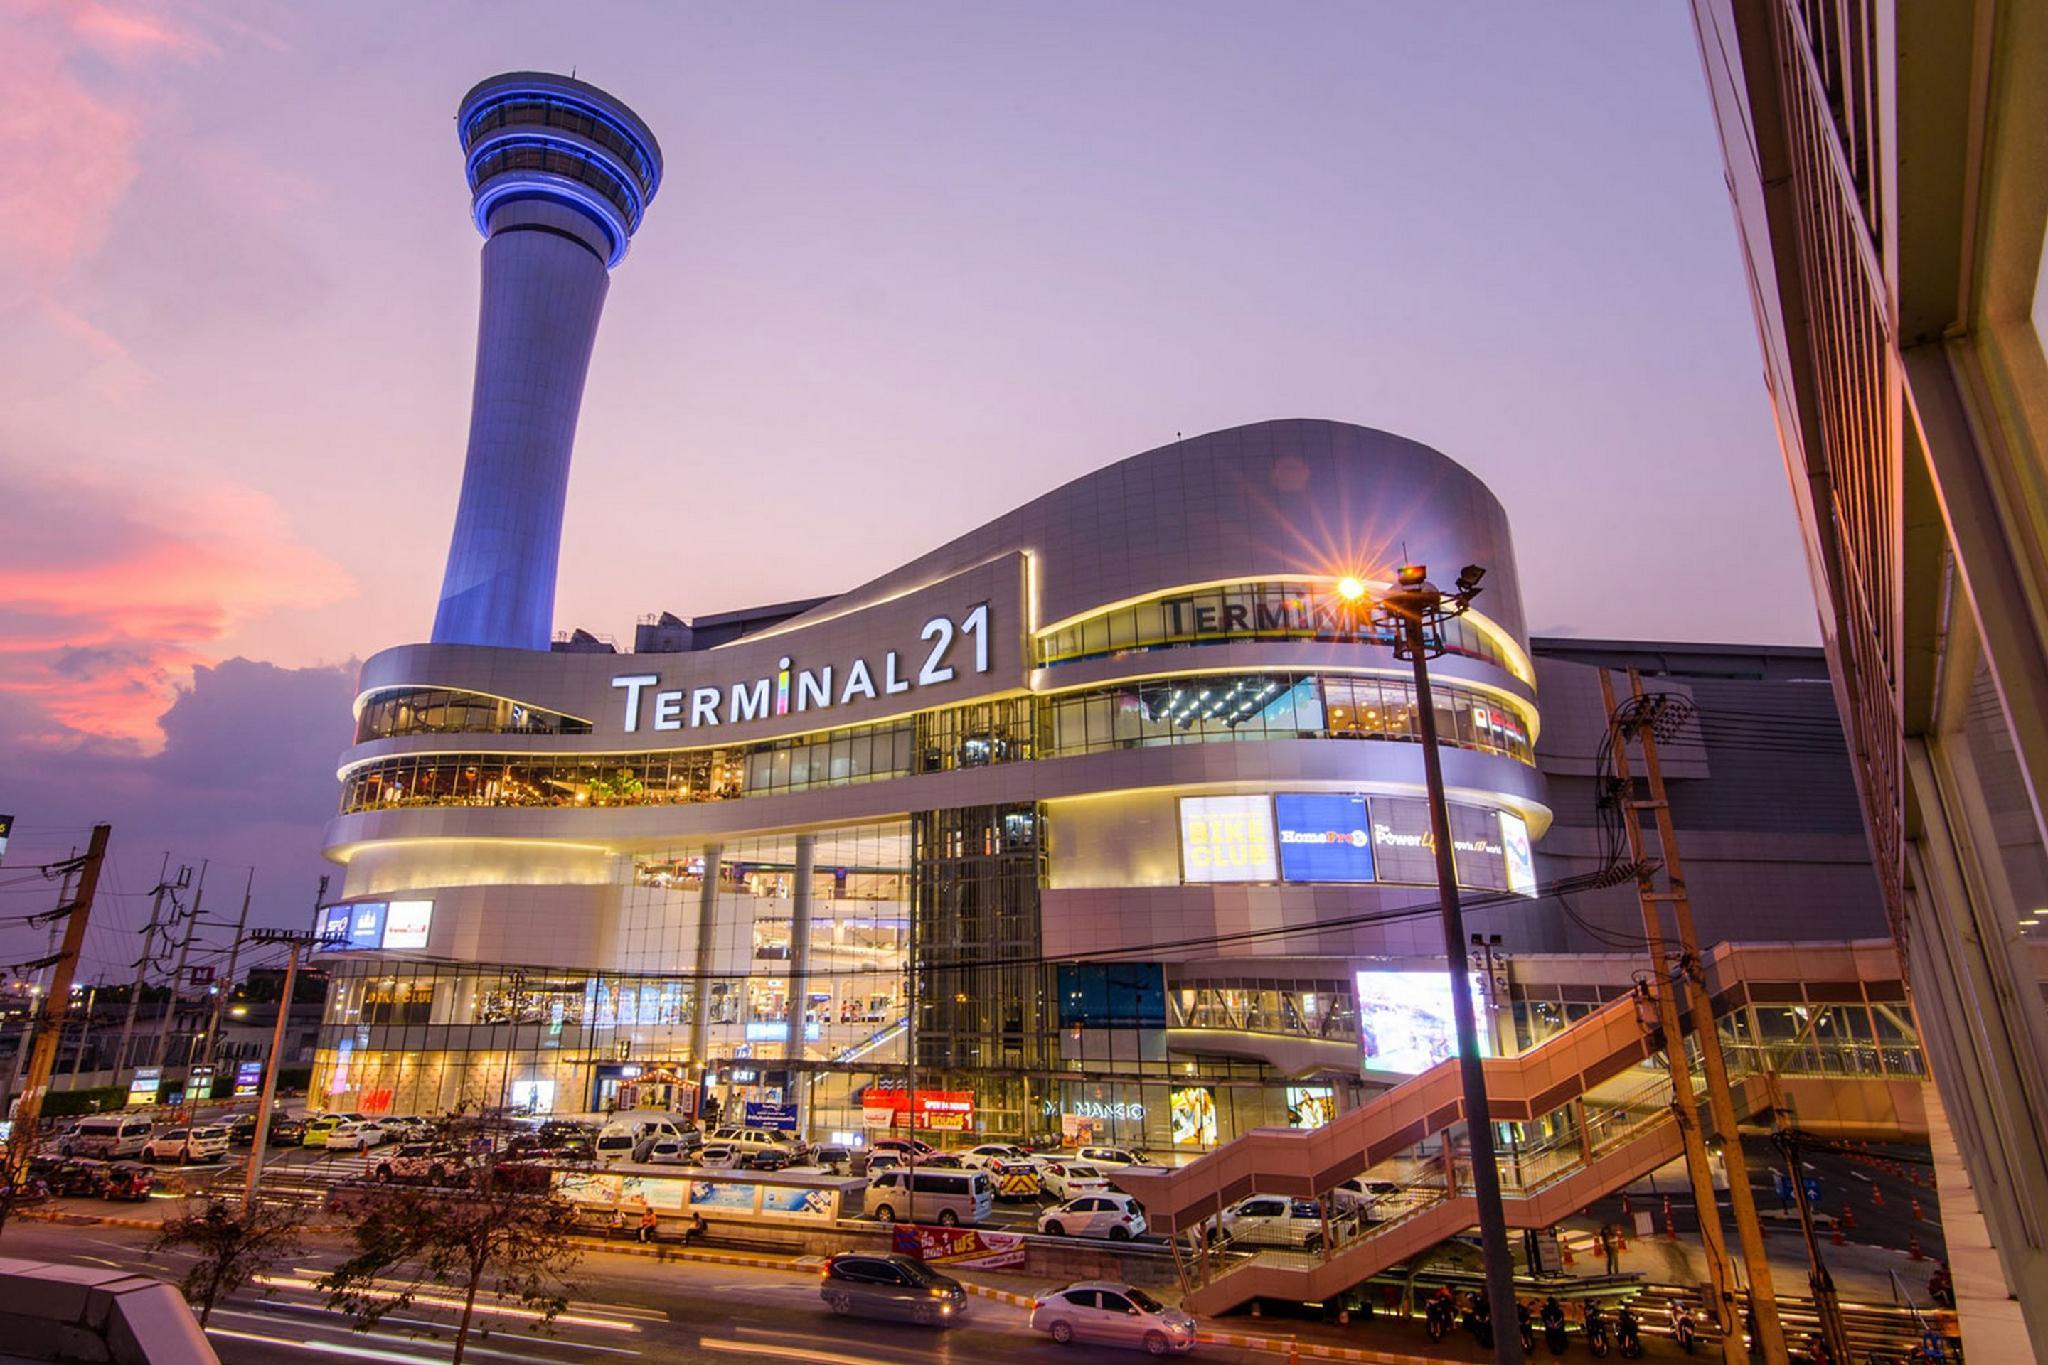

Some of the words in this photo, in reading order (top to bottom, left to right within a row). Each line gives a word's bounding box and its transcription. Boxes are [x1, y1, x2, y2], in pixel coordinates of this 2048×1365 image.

[1188, 817, 1266, 844] BIKE
[1190, 844, 1269, 867] CLUB
[1075, 1101, 1146, 1120] MANGO
